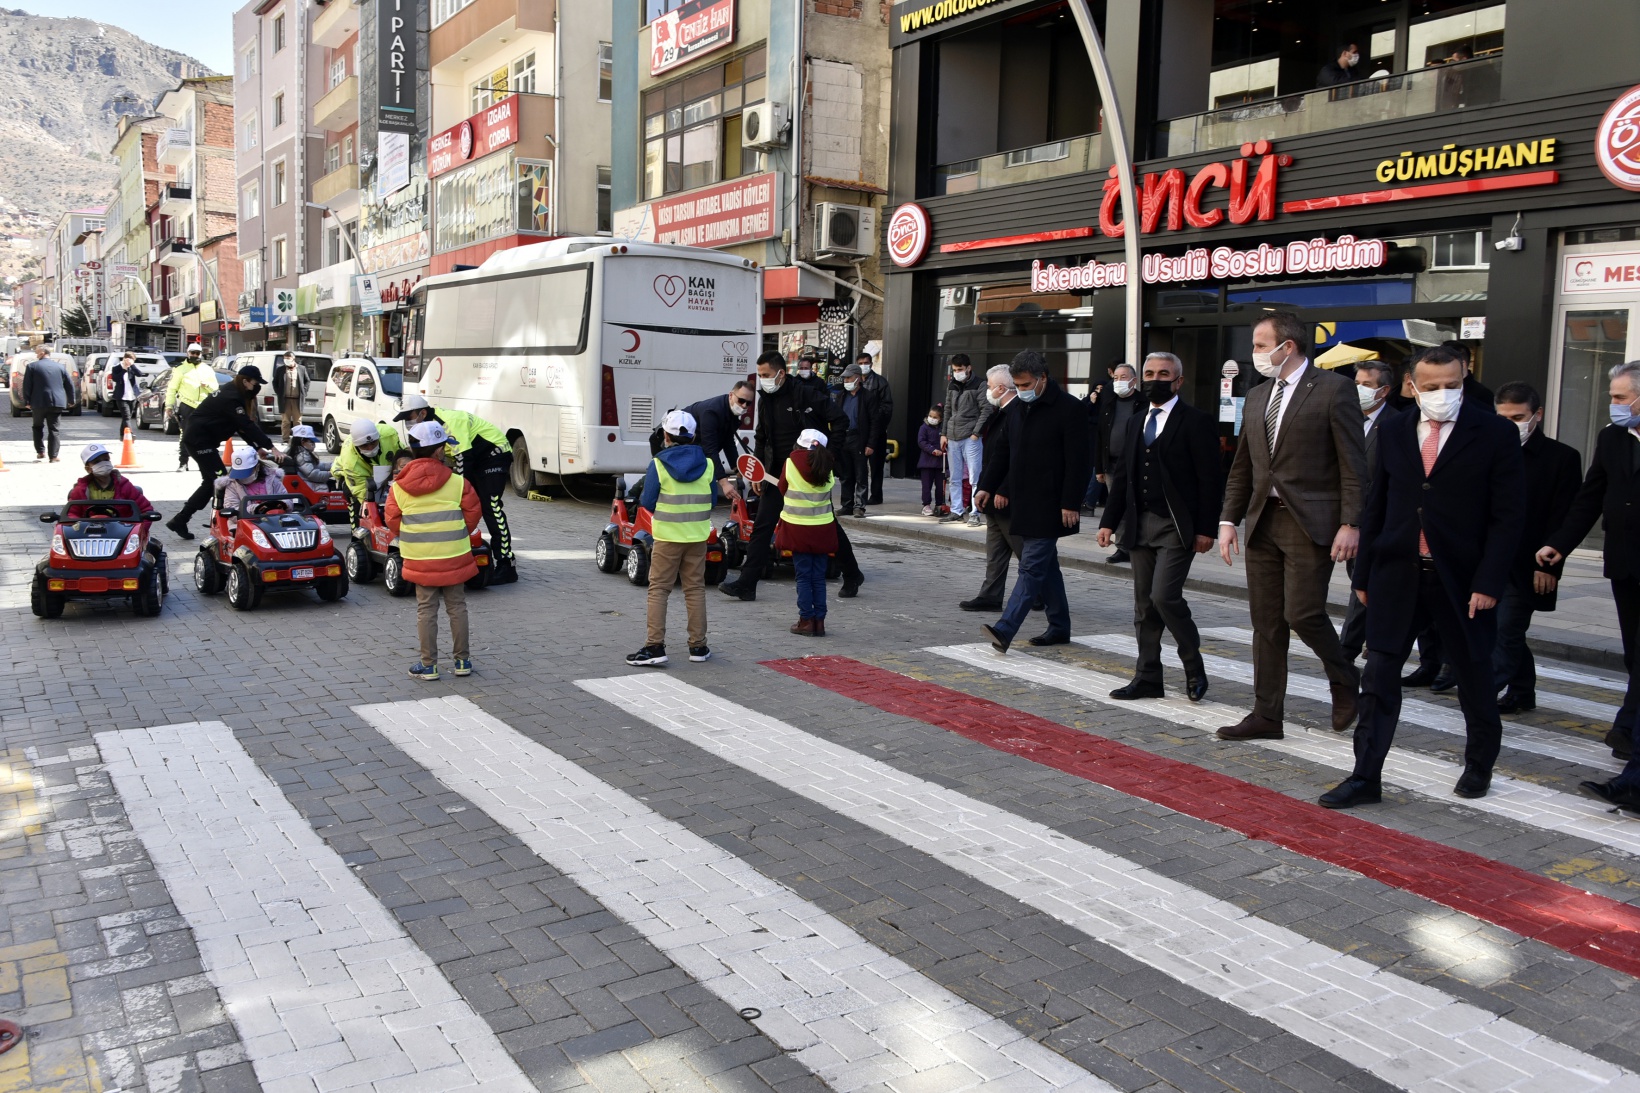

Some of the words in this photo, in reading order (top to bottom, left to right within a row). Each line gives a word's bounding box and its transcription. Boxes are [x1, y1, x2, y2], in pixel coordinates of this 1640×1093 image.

[487, 103, 511, 127] IZGARA
[431, 132, 452, 154] MERKEZ
[488, 126, 511, 151] ÇORBA
[432, 152, 451, 173] DÜRÜM
[1376, 138, 1556, 183] GÜMÜŞHANE
[696, 194, 721, 218] ARTABEL
[722, 185, 742, 212] VADİSİ
[743, 179, 769, 208] KÖYLERİ
[696, 224, 704, 243] VE
[706, 217, 740, 242] DAYANIŞMA
[742, 208, 769, 236] DERNEĞİ
[1031, 259, 1128, 293] İskenderu
[1142, 247, 1211, 284] Usulü
[1211, 242, 1285, 279] Soslu
[1285, 234, 1385, 275] Dürüm
[688, 276, 715, 290] KAN
[688, 288, 715, 298] BAĞIŞI
[688, 298, 714, 306] HAYAT
[744, 458, 756, 479] DUR
